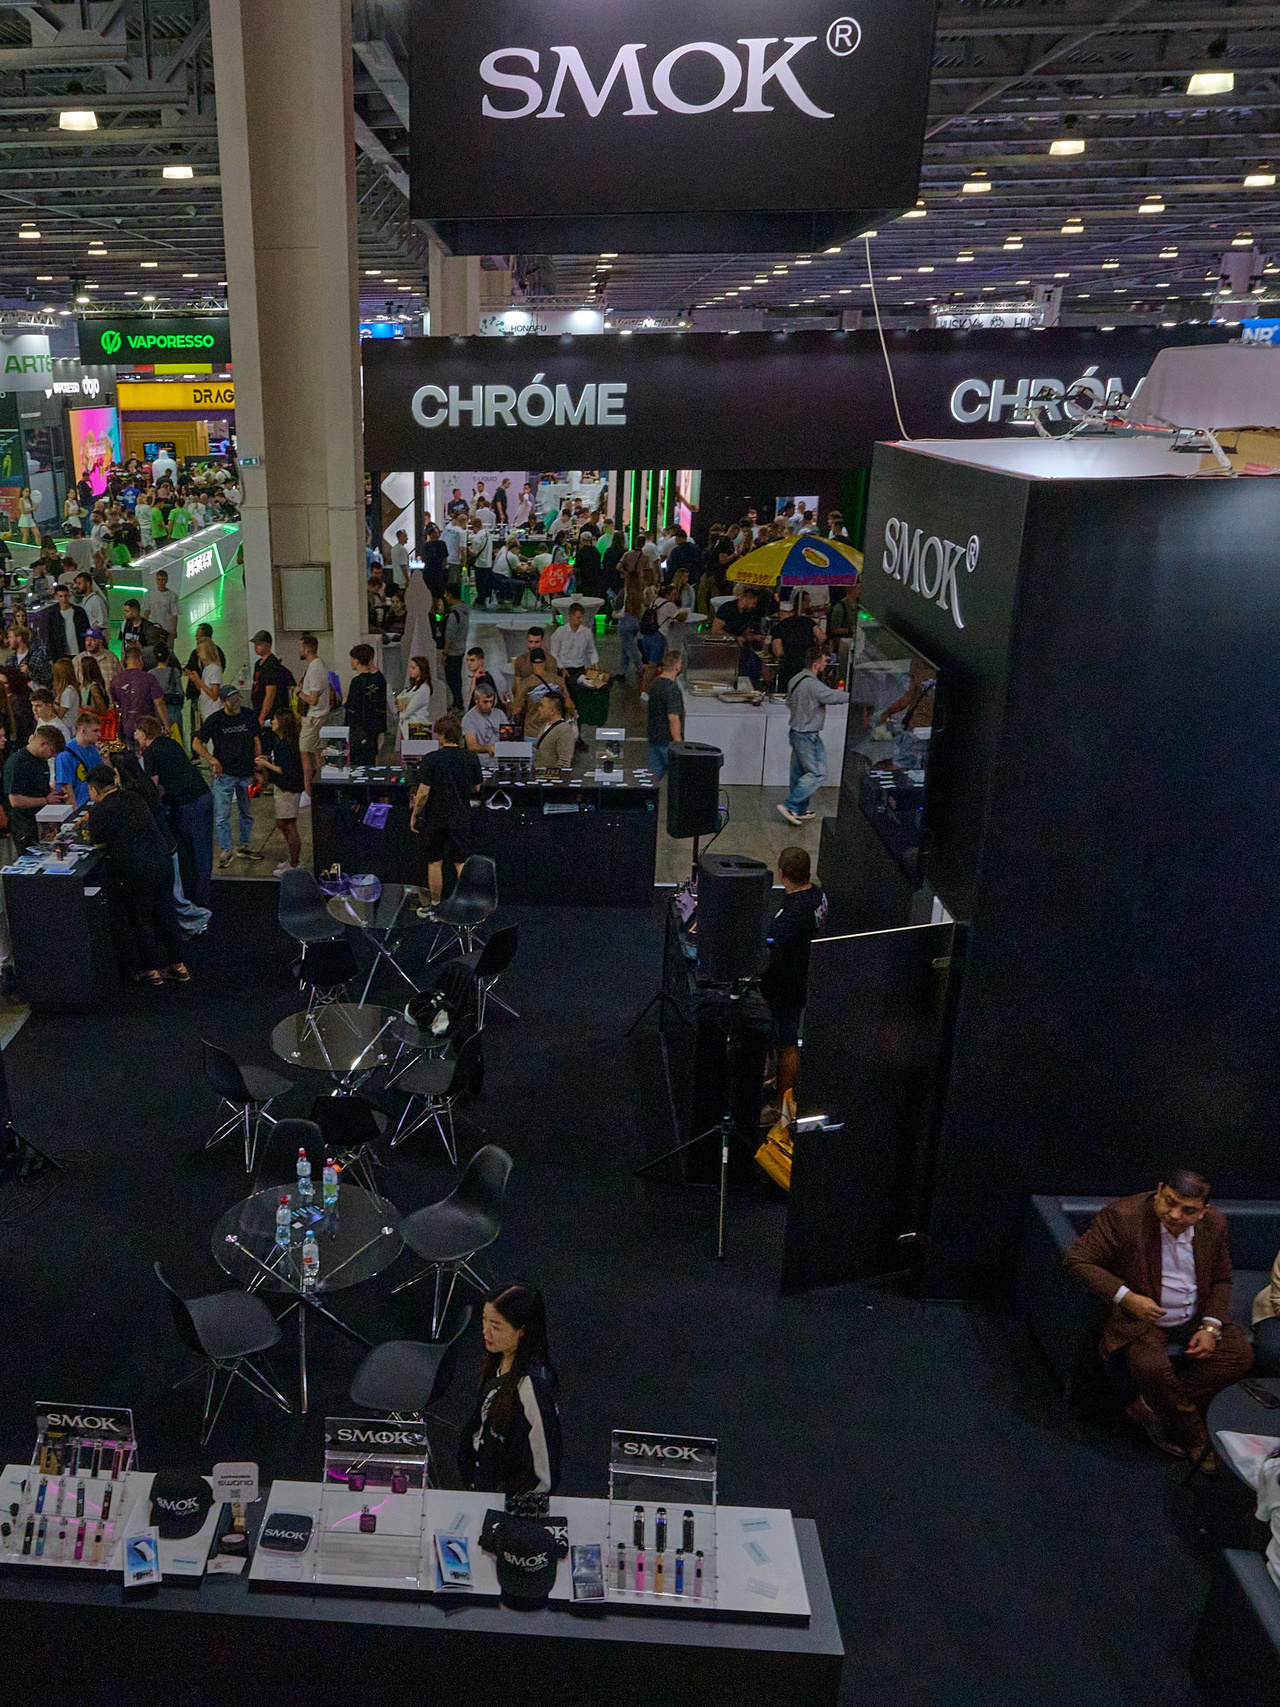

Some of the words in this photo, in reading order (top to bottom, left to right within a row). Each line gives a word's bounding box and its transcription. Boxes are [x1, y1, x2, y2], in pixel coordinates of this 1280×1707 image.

[127, 334, 215, 349] VAPORESSO
[46, 1413, 121, 1433] SMOK
[337, 1428, 418, 1447] SMOK
[623, 1442, 703, 1463] SMOK
